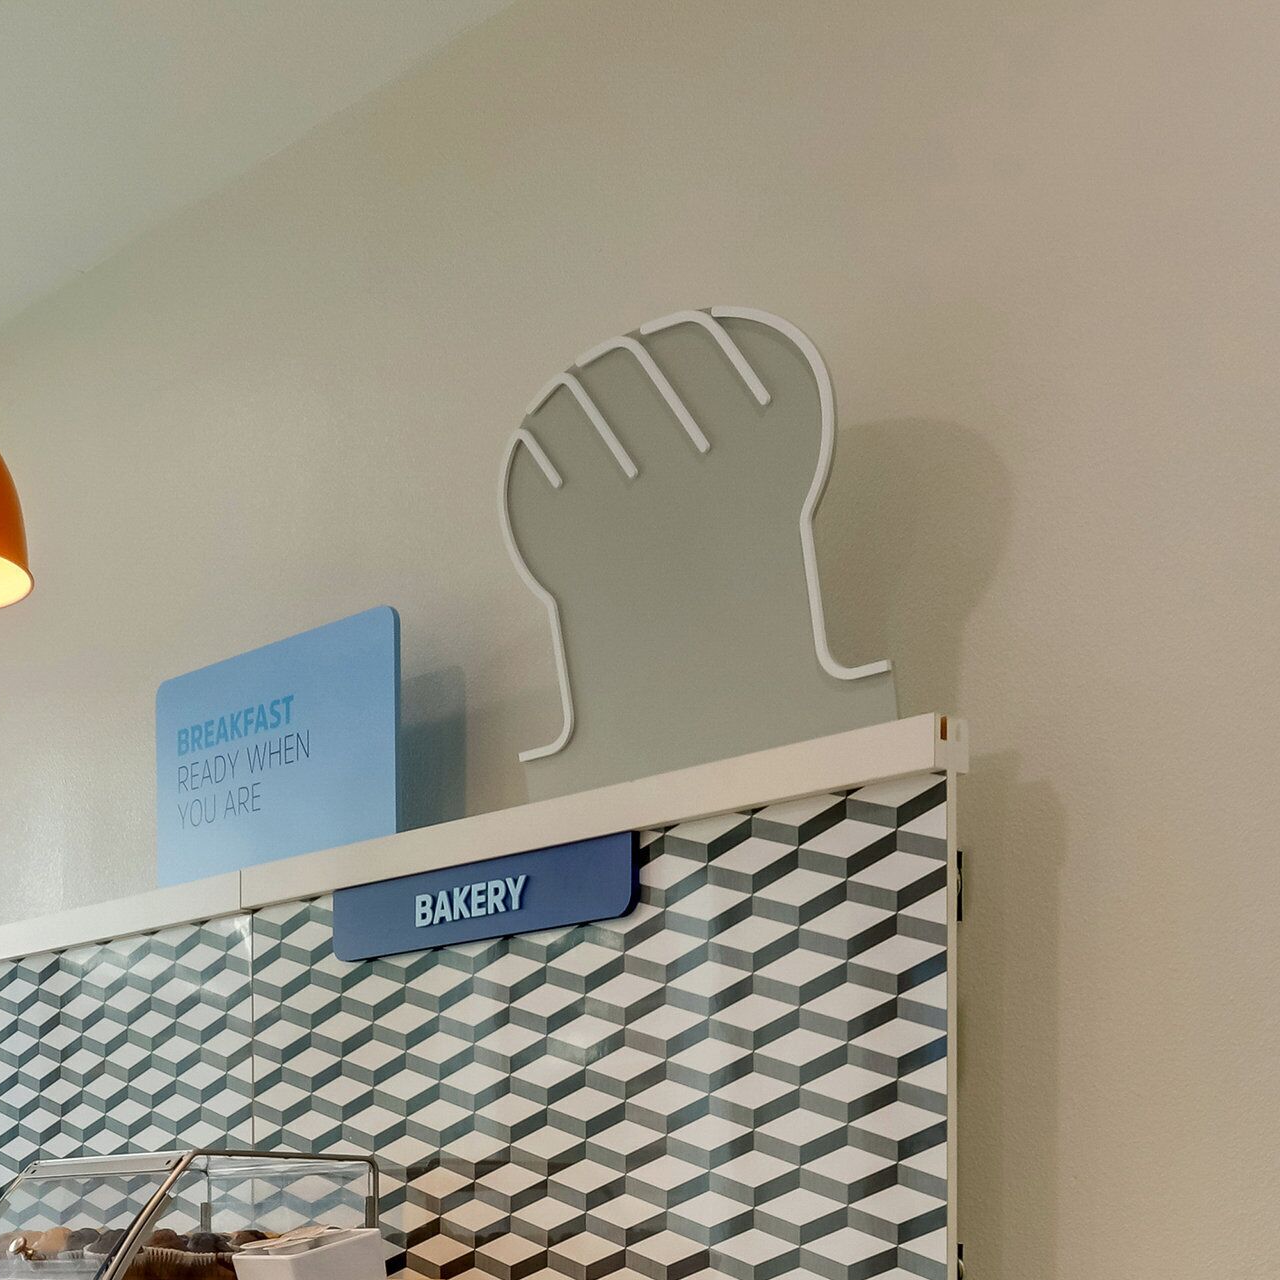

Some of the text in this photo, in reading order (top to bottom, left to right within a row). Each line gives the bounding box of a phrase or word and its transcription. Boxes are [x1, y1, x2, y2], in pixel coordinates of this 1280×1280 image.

[177, 694, 294, 756] BREAKFAST
[177, 729, 310, 793] READY WHEN
[177, 782, 261, 829] YOU ARE
[415, 874, 528, 928] BAKERY
